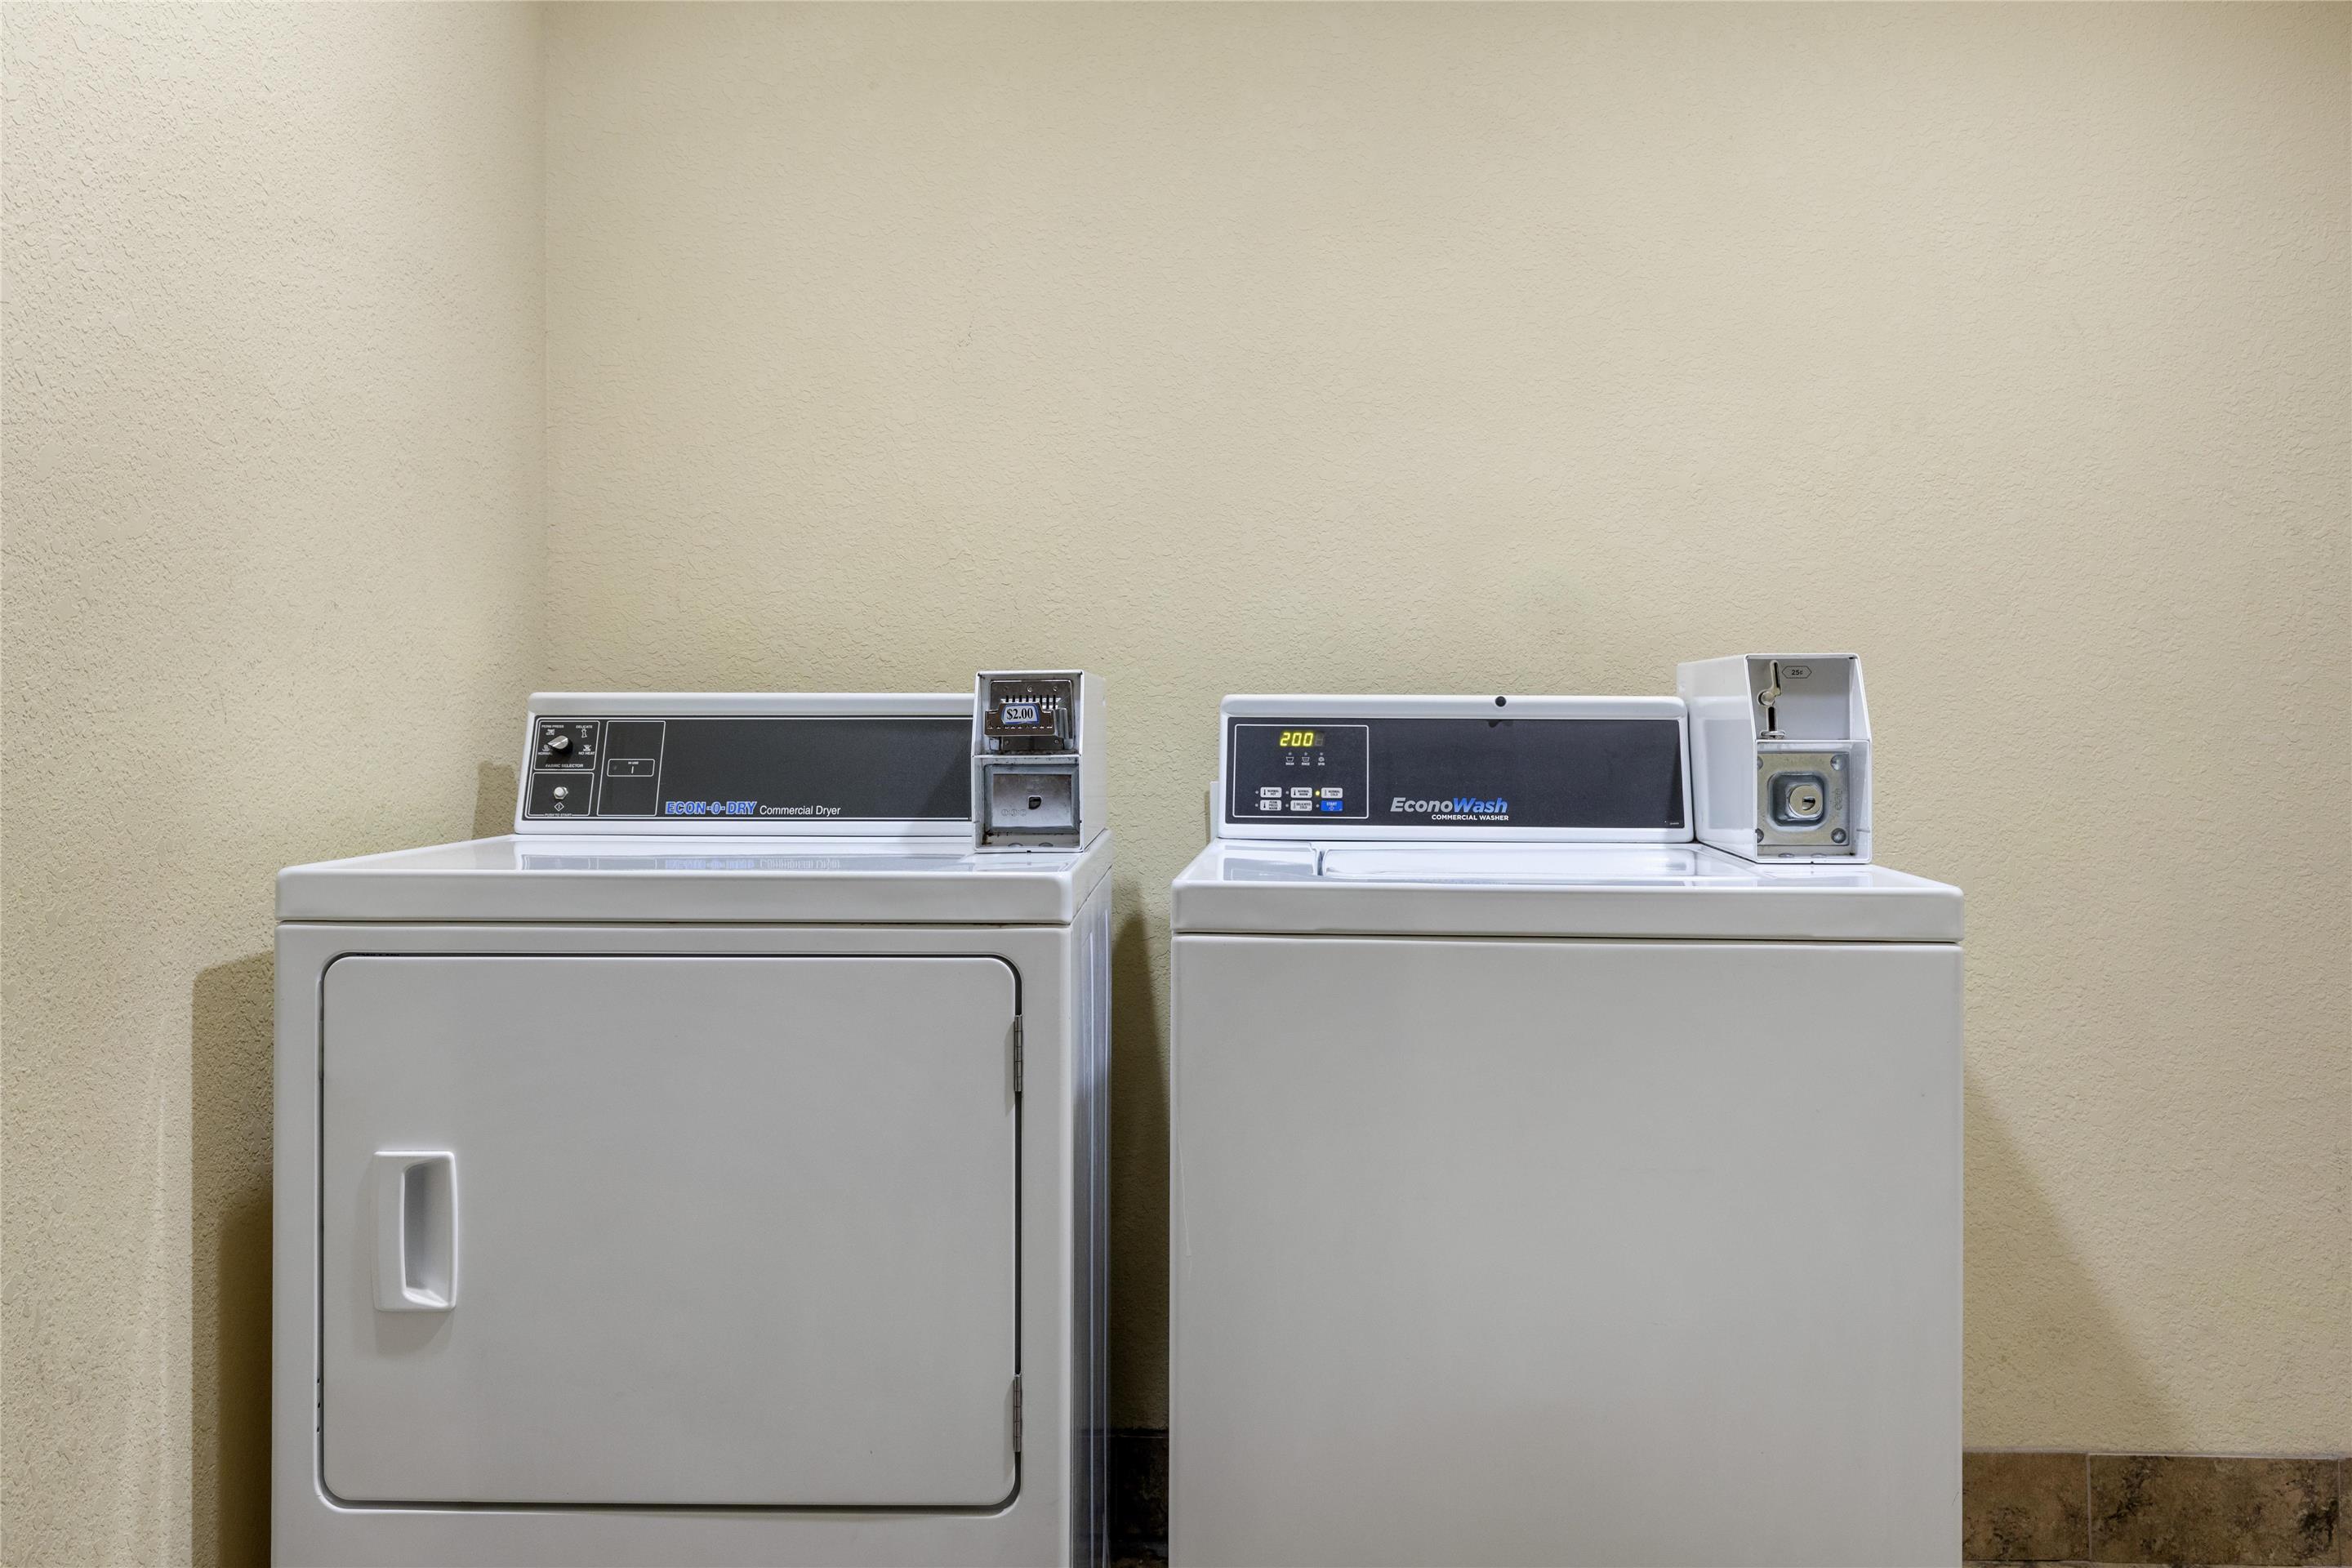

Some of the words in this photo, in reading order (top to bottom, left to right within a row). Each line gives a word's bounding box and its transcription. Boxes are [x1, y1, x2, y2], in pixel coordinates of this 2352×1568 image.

[1006, 708, 1033, 719] $2.00
[1280, 732, 1313, 746] 200
[665, 801, 757, 814] ECON-O-DRY
[760, 805, 813, 815] Commercial
[816, 805, 841, 817] Dryer
[1390, 797, 1508, 813] EconoWash
